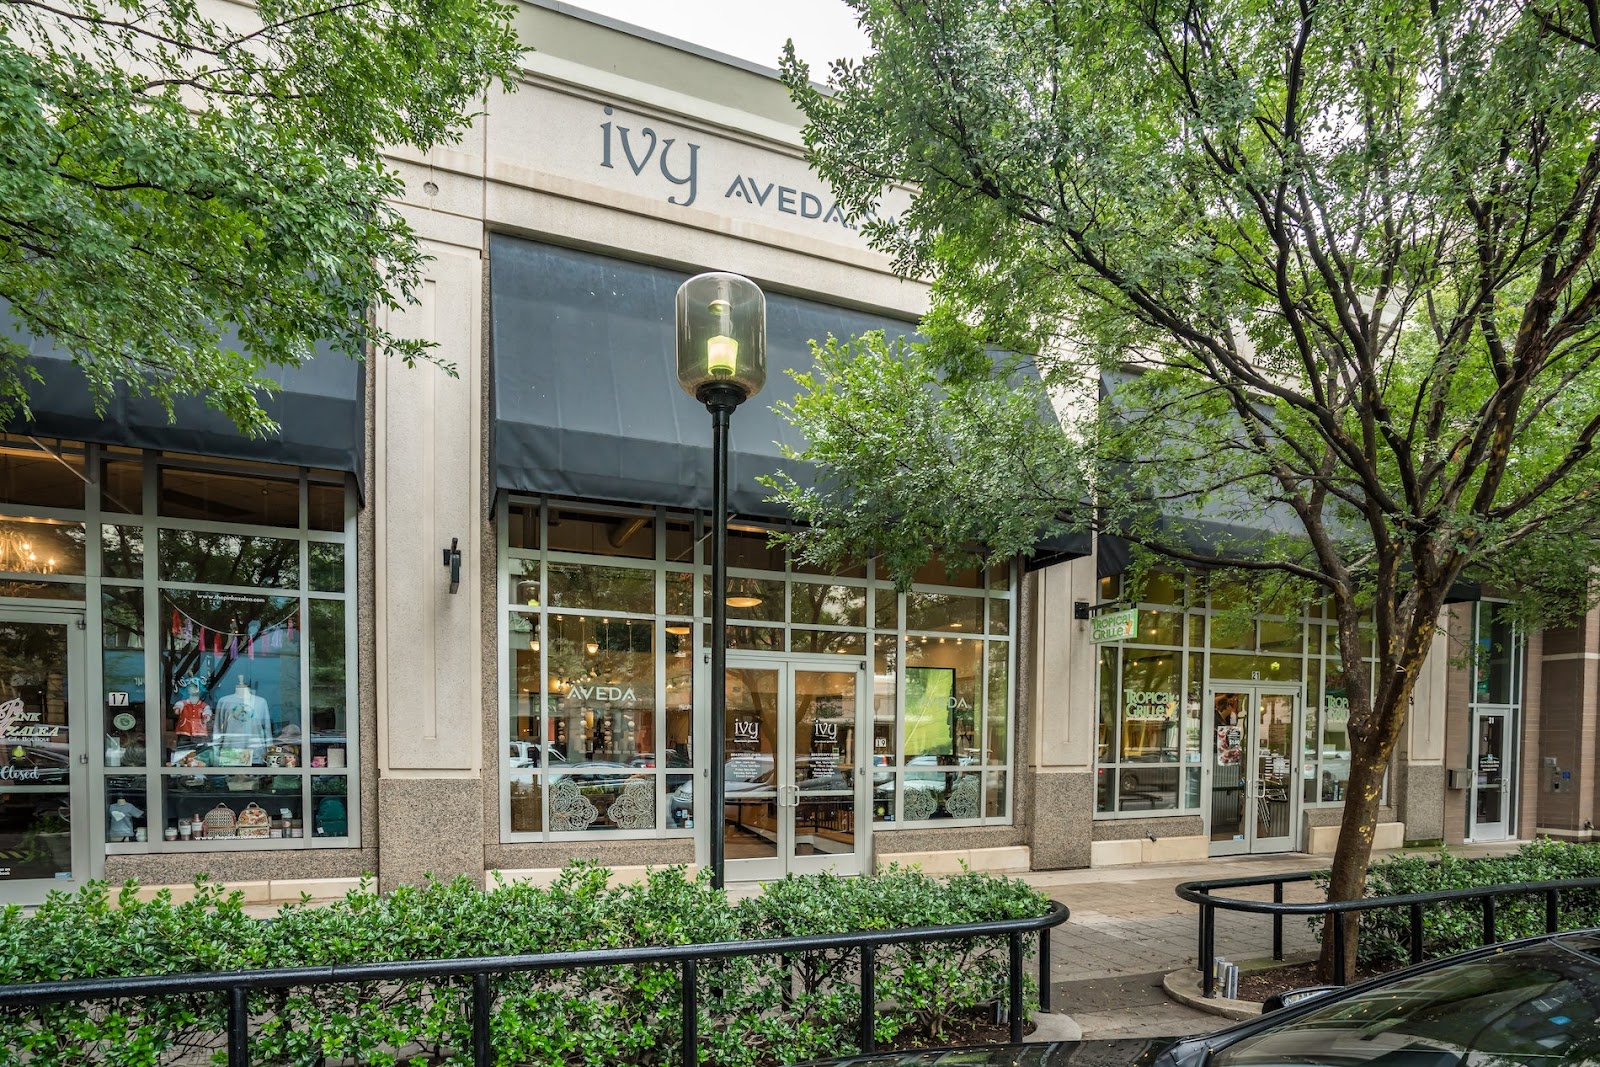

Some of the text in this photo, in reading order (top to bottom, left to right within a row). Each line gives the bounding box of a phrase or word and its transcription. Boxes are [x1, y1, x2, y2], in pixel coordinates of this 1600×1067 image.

[600, 105, 700, 206] ivy
[725, 174, 848, 229] AVEDA
[112, 693, 127, 705] 17
[566, 686, 638, 701] AVEDA
[735, 718, 759, 740] ivy
[814, 719, 837, 740] ivy
[0, 765, 40, 780] Closed
